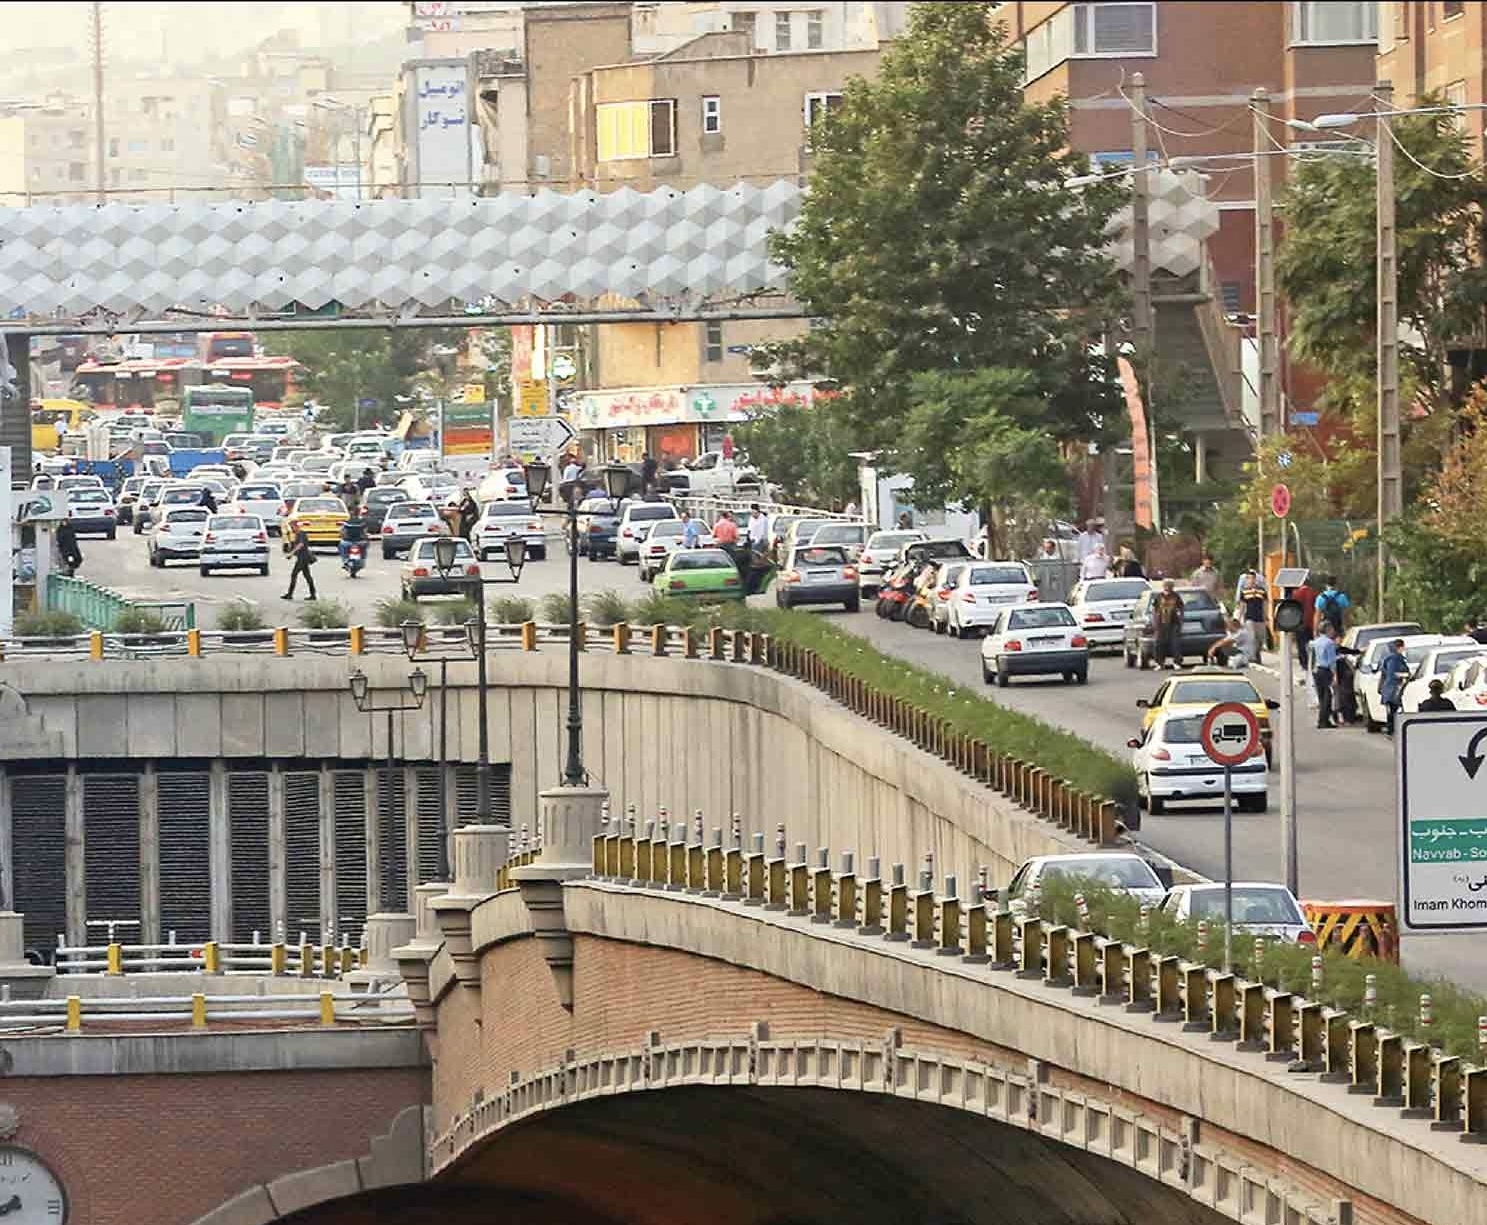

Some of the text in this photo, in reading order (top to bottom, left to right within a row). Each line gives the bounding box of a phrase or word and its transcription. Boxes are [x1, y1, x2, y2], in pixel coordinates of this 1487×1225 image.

[1412, 825, 1457, 842] جنوب
[1413, 847, 1461, 860] Navvab
[1414, 899, 1449, 911] Imam
